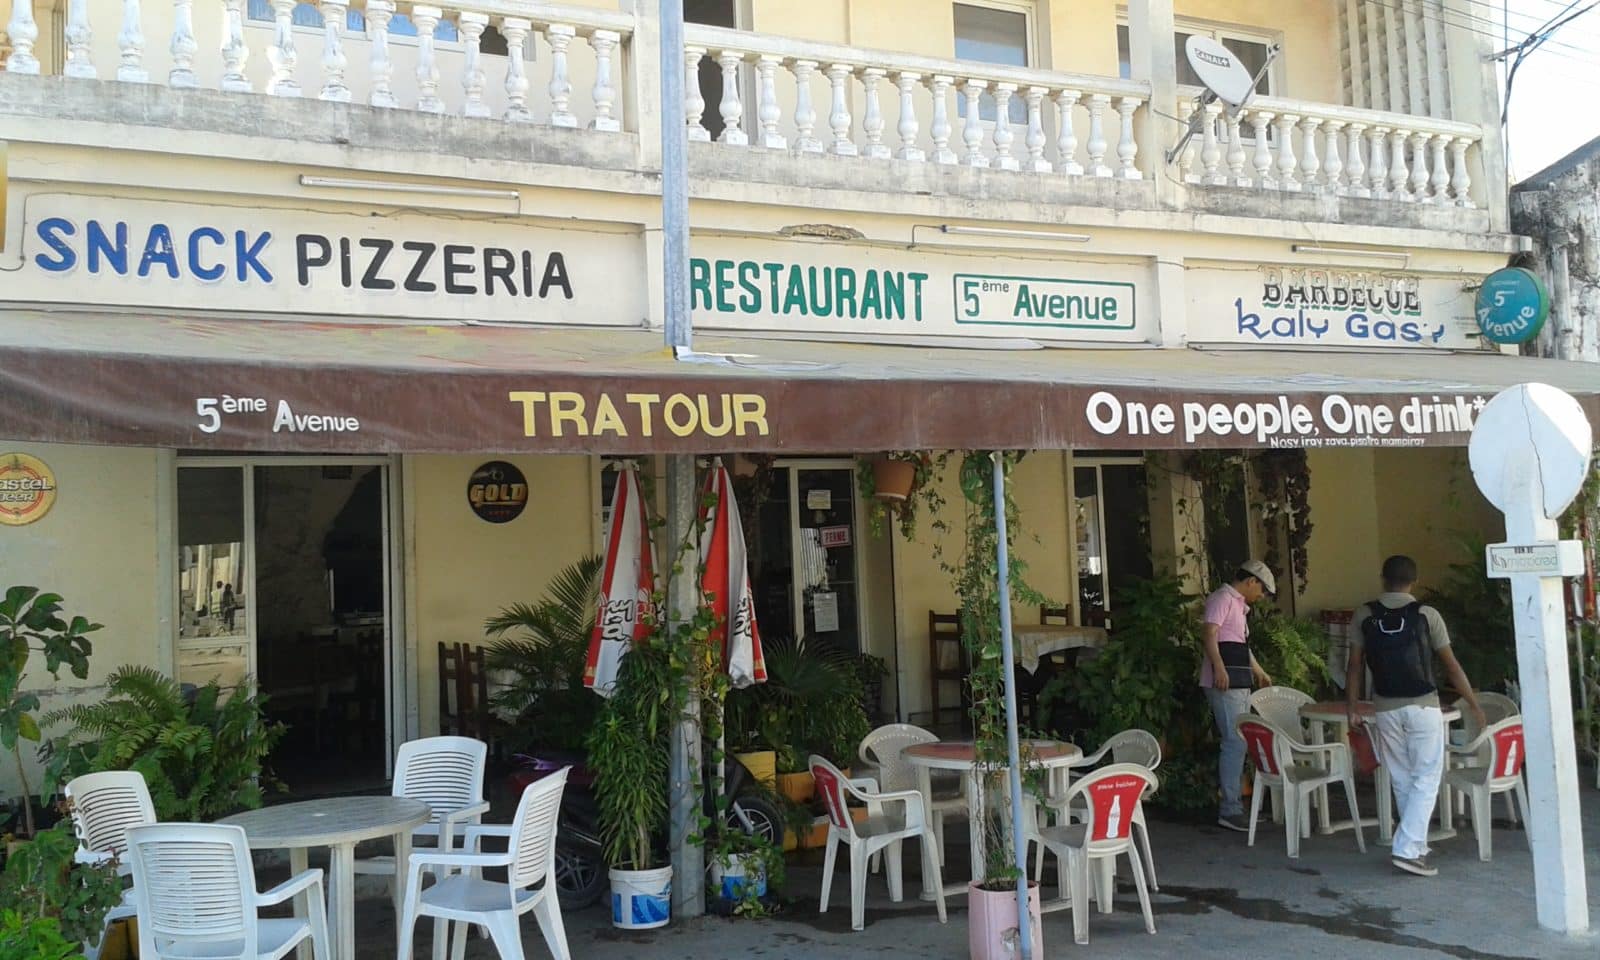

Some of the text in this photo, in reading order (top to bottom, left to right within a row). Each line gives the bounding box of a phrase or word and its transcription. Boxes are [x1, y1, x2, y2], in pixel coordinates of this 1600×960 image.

[35, 217, 574, 300] SNACK PIZZERIA
[690, 258, 929, 322] RESTAURANT
[963, 280, 1118, 321] 5ème Avenue
[1262, 268, 1422, 316] BARBECUE
[1478, 306, 1535, 337] Avenue
[196, 394, 360, 433] 5ème Avenue
[508, 391, 770, 437] TRATOUR
[1086, 391, 1176, 435] One
[1182, 395, 1320, 443] people,
[1321, 394, 1394, 434] One
[1270, 435, 1299, 449] Nosy
[1301, 436, 1323, 448] iray
[0, 476, 53, 491] astel
[470, 484, 527, 504] GOLD
